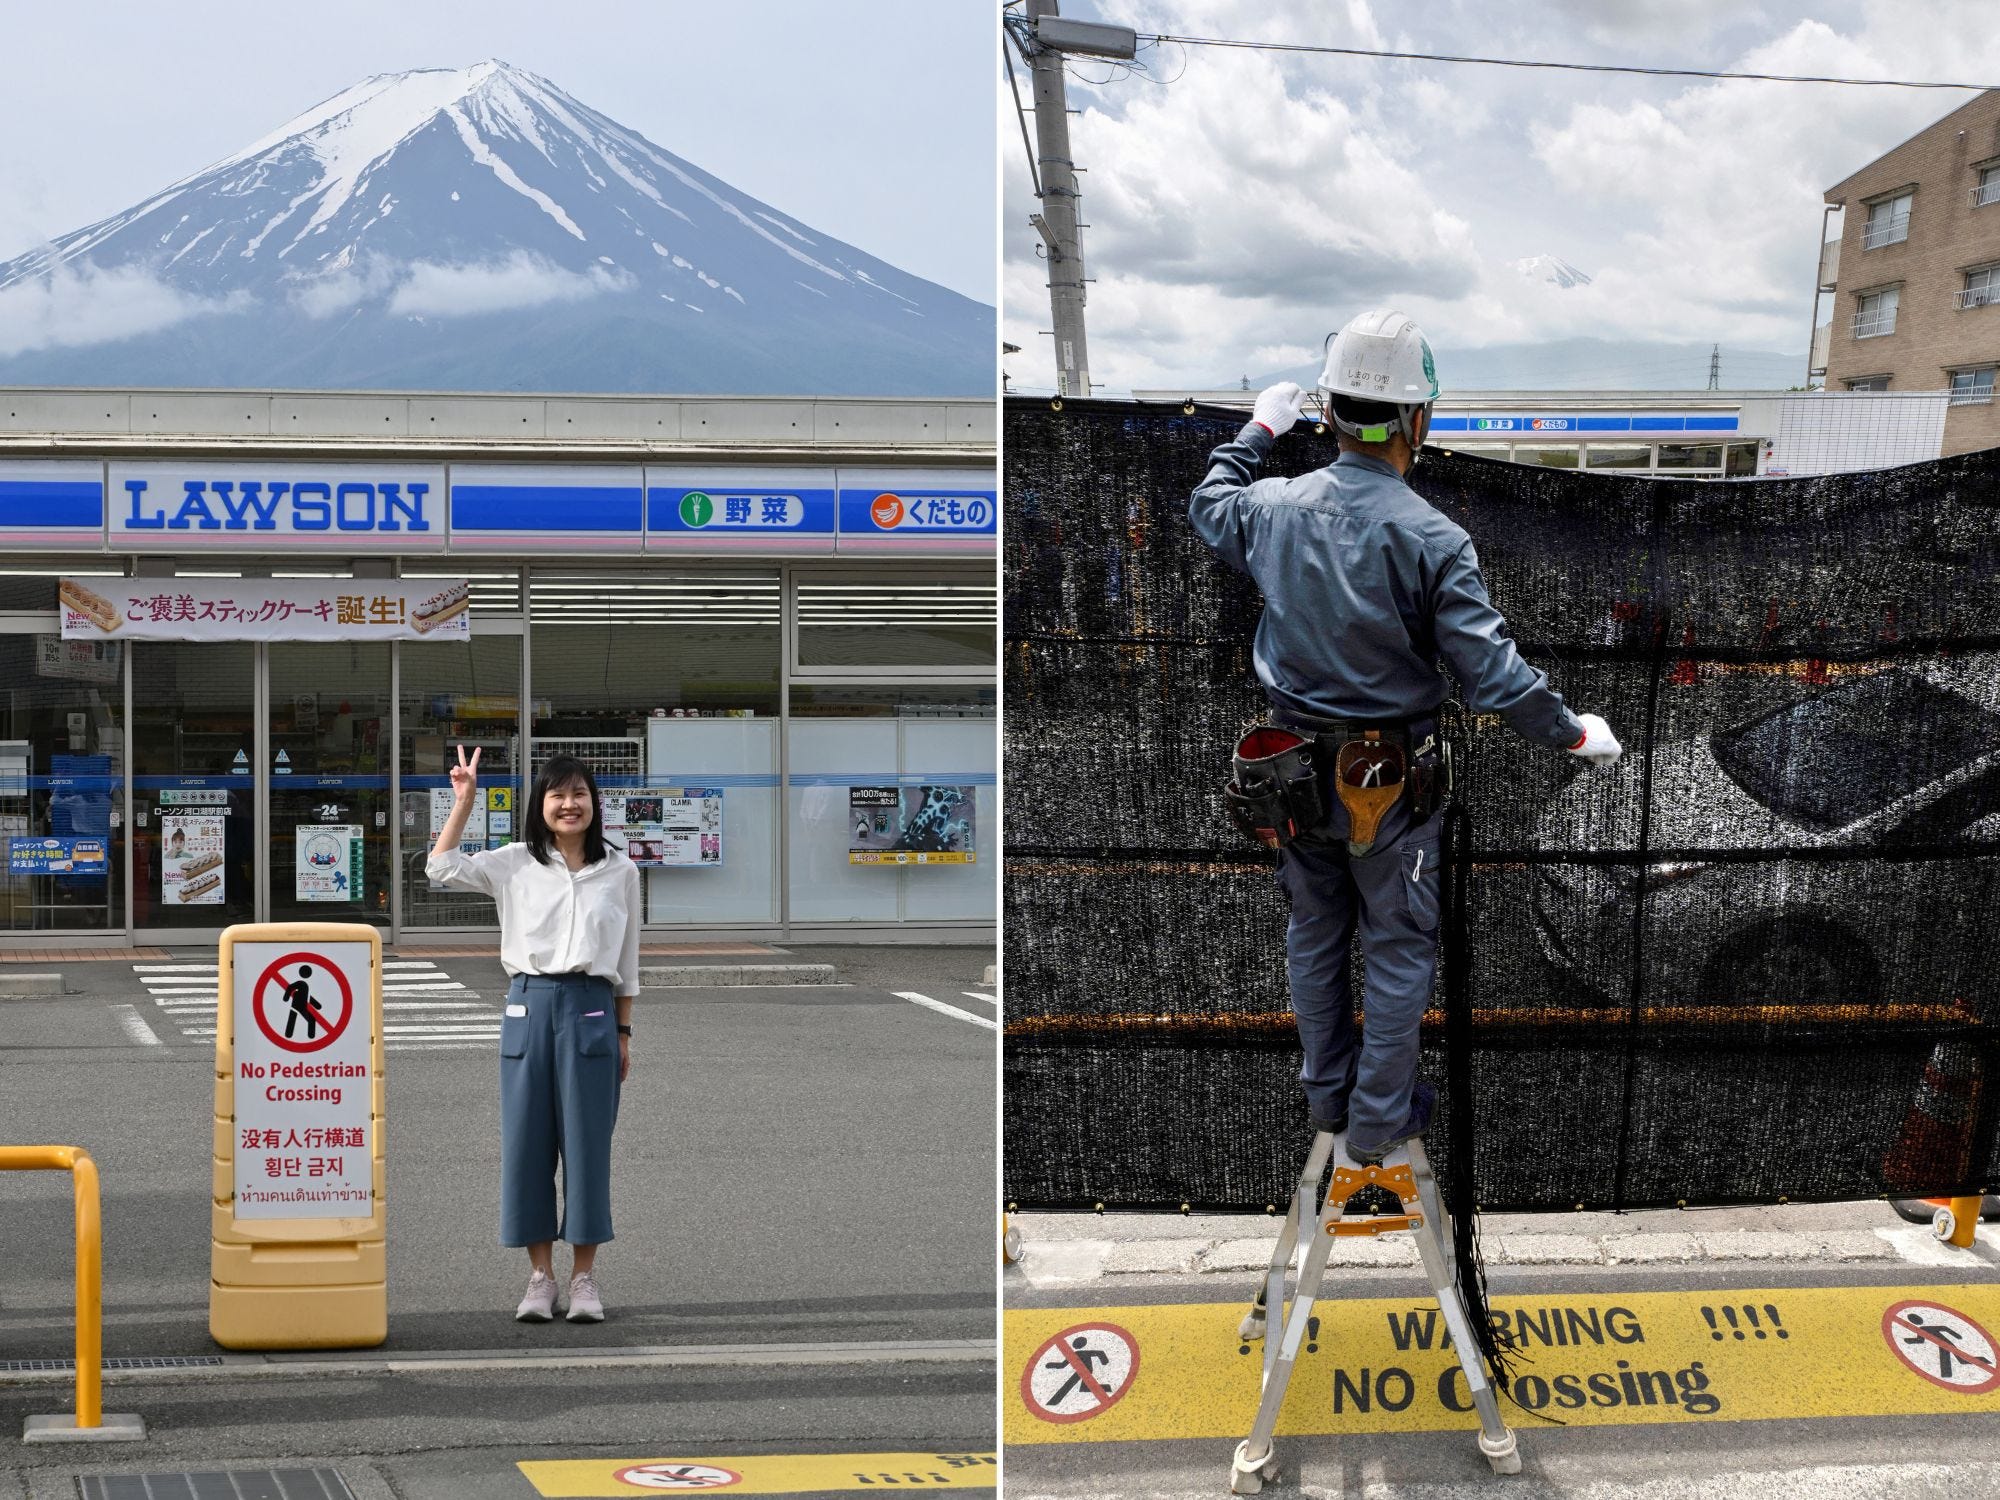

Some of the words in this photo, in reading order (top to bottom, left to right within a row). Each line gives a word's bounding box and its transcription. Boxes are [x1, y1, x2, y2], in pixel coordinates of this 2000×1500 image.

[125, 480, 430, 531] LAWSON
[725, 497, 789, 524] 野菜
[909, 498, 987, 526] くだもの
[67, 612, 91, 621] New
[321, 804, 338, 816] 24
[164, 871, 183, 879] New
[241, 1062, 265, 1078] No
[270, 1062, 366, 1078] Pedestrian
[265, 1085, 342, 1104] Crossing
[241, 1127, 365, 1149] 没有人行横道
[265, 1157, 302, 1177] 횡단
[308, 1157, 343, 1177] 금지
[241, 1182, 367, 1204] ห้ามคนเดินเท้าข้าม
[1334, 1367, 1415, 1414] NO
